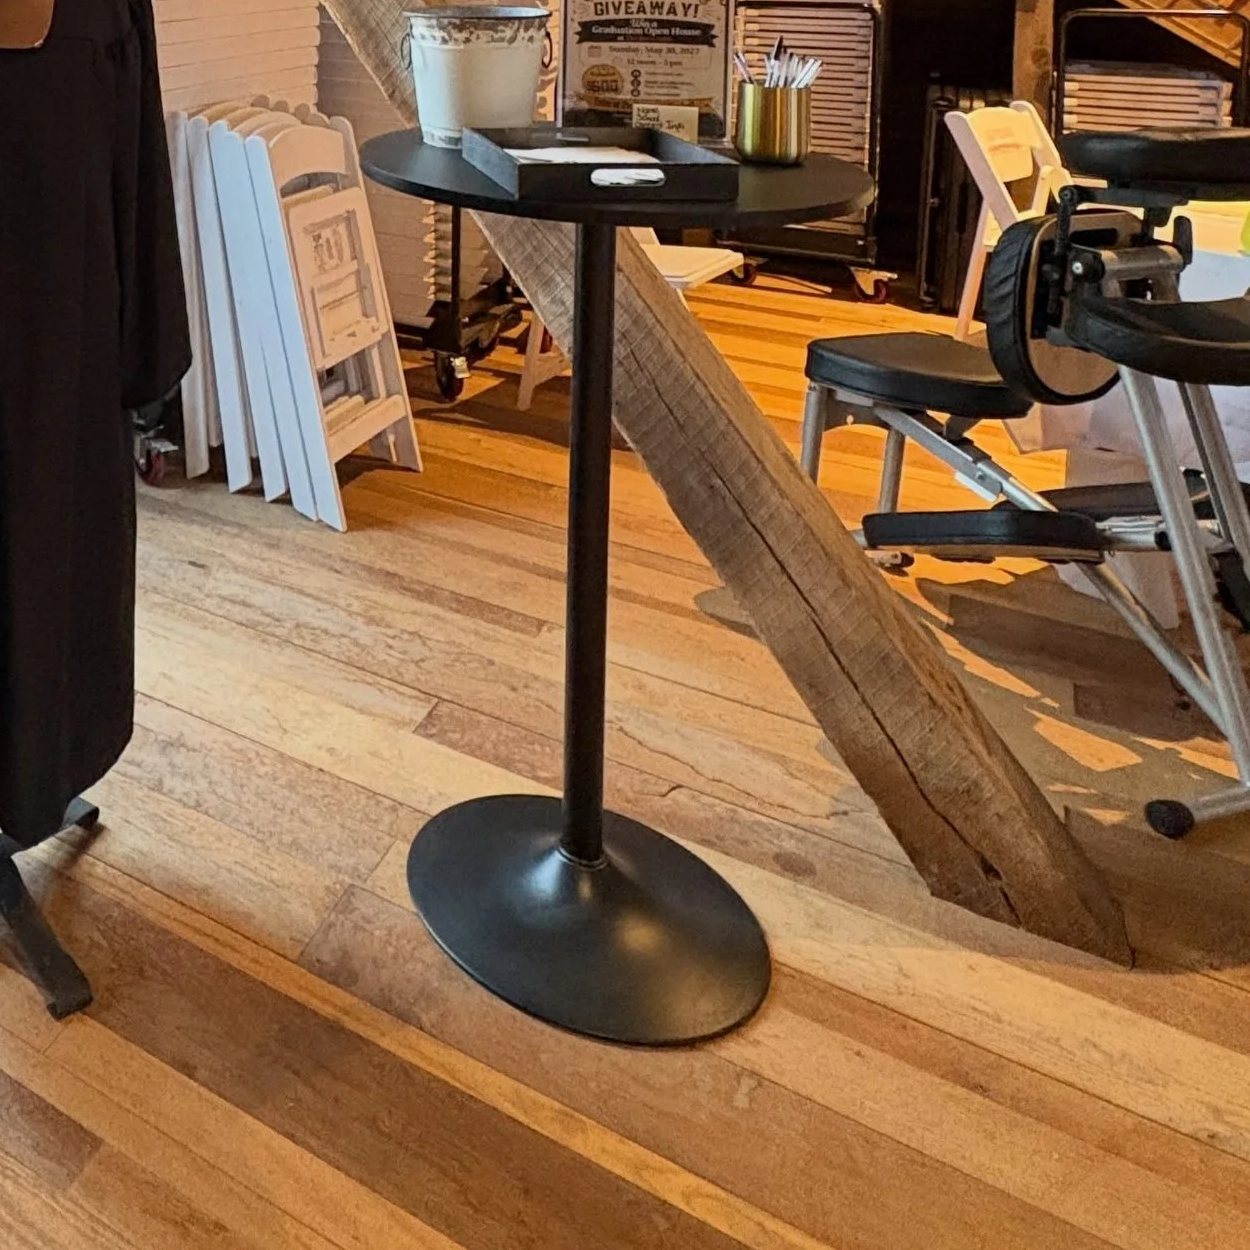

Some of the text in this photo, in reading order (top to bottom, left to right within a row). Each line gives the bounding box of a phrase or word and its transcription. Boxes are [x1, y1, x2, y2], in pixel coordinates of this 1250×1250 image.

[594, 1, 700, 19] GIVEAWAY!
[591, 25, 702, 37] Graduation Open House
